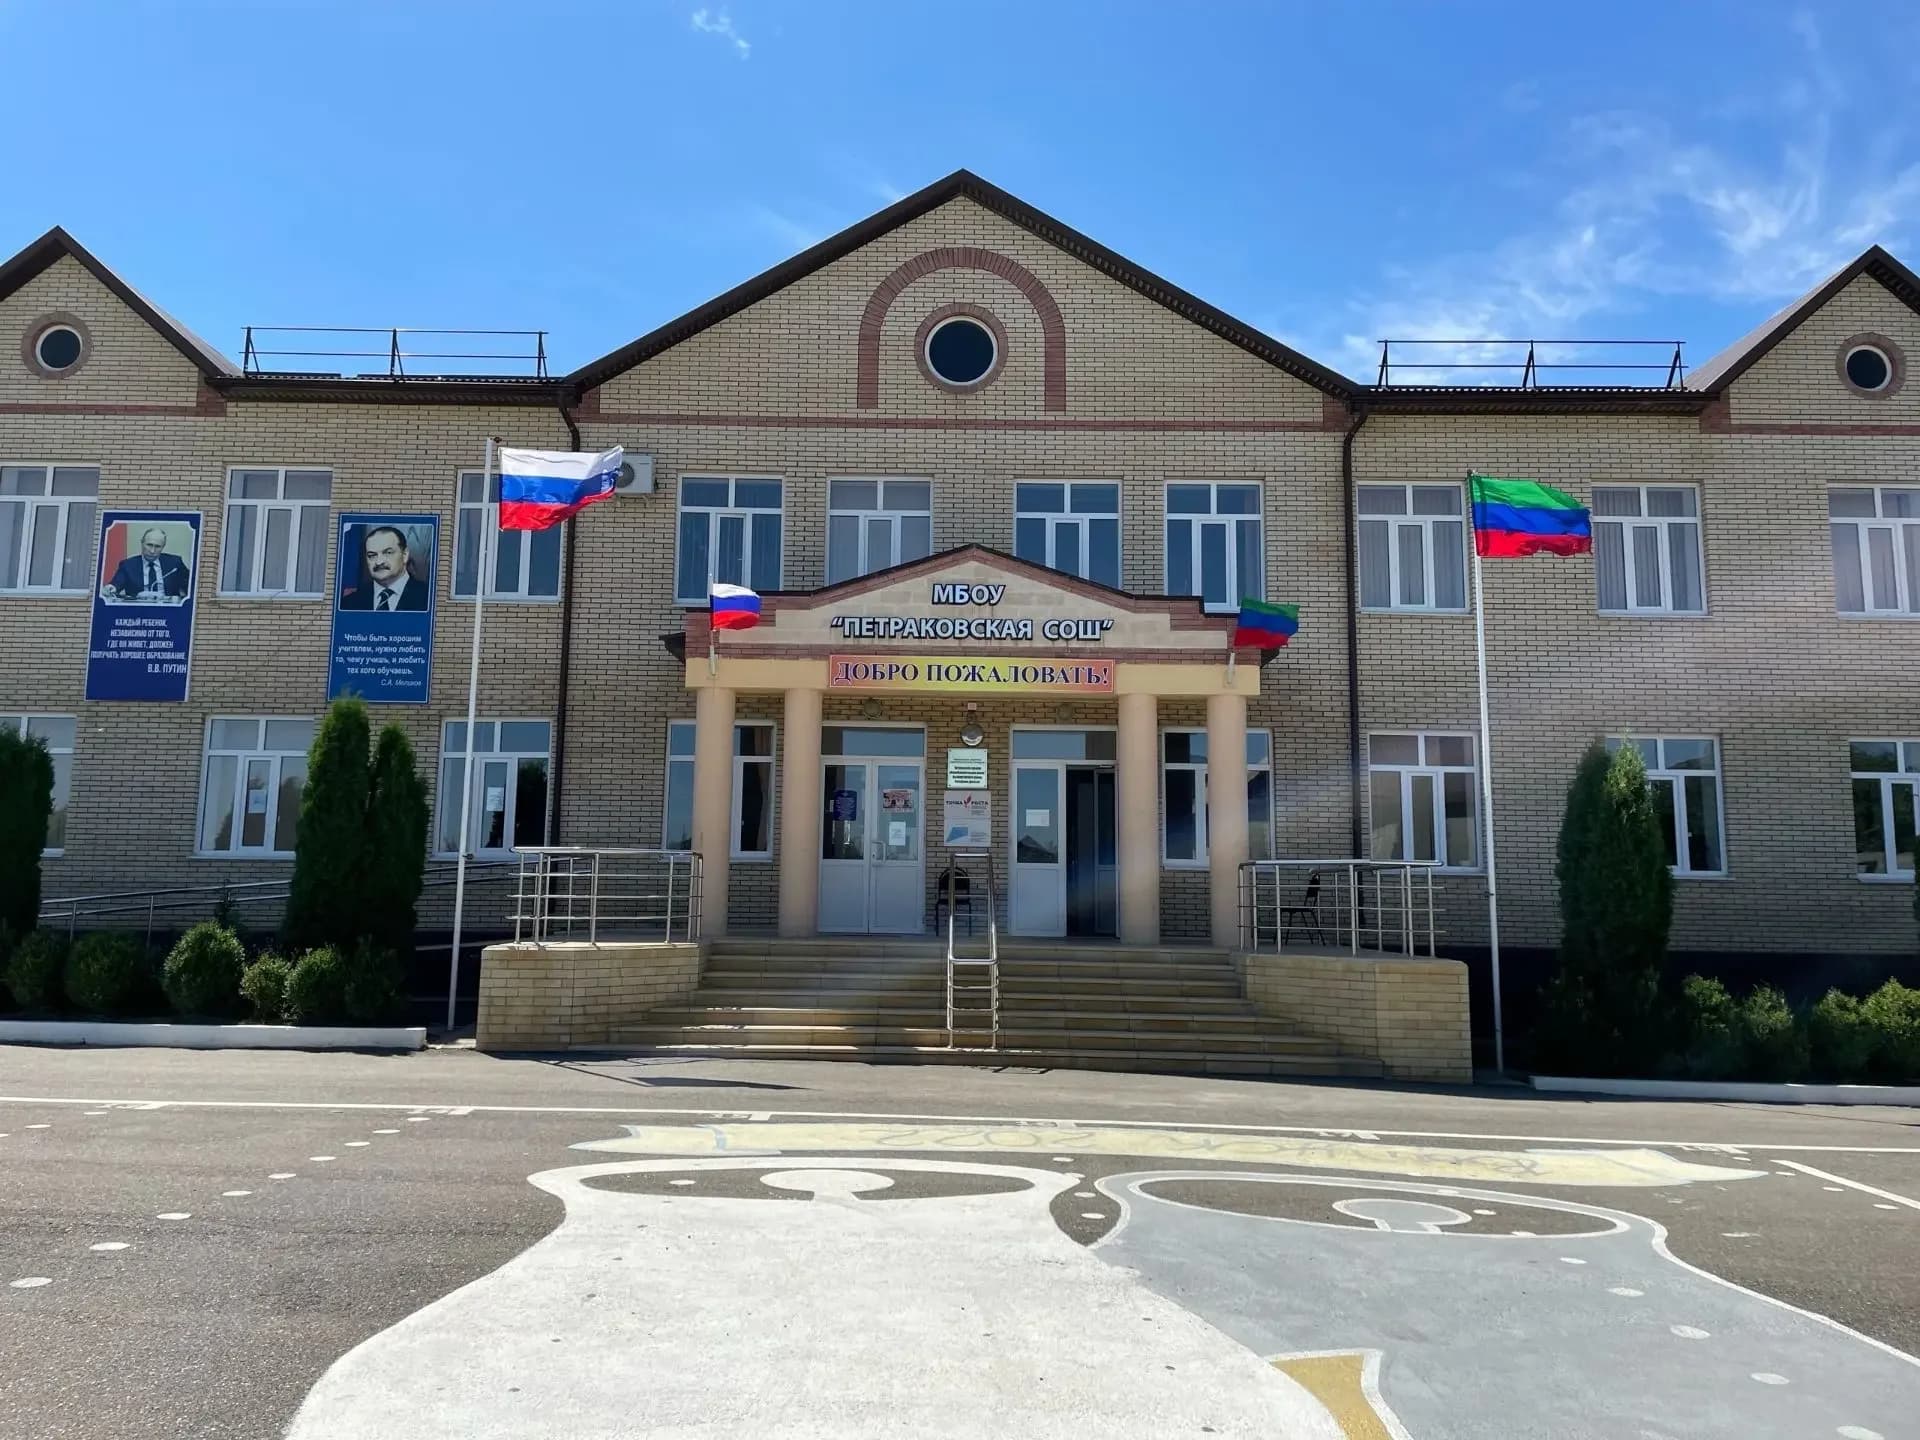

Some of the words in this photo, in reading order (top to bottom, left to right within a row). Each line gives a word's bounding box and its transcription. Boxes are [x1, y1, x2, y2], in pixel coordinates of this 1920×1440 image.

[931, 583, 1006, 605] МБОУ
[115, 618, 140, 627] КАЖДЫЙ
[147, 629, 155, 637] ОТ
[344, 633, 368, 642] Чтобы
[369, 633, 388, 642] быть
[388, 635, 422, 643] хорошим
[107, 640, 119, 648] ГДЕ
[148, 640, 174, 649] ДОЛЖЕН
[375, 646, 397, 654] нужно
[398, 645, 426, 654] любить
[398, 655, 425, 664] любить
[147, 663, 161, 673] В.В.
[163, 663, 187, 673] ПУТИН
[360, 667, 376, 675] кого
[834, 661, 919, 684] ДОБРО
[926, 663, 1109, 685] ПОЖАЛОВАТЬ!
[860, 1128, 1098, 1148] 2022
